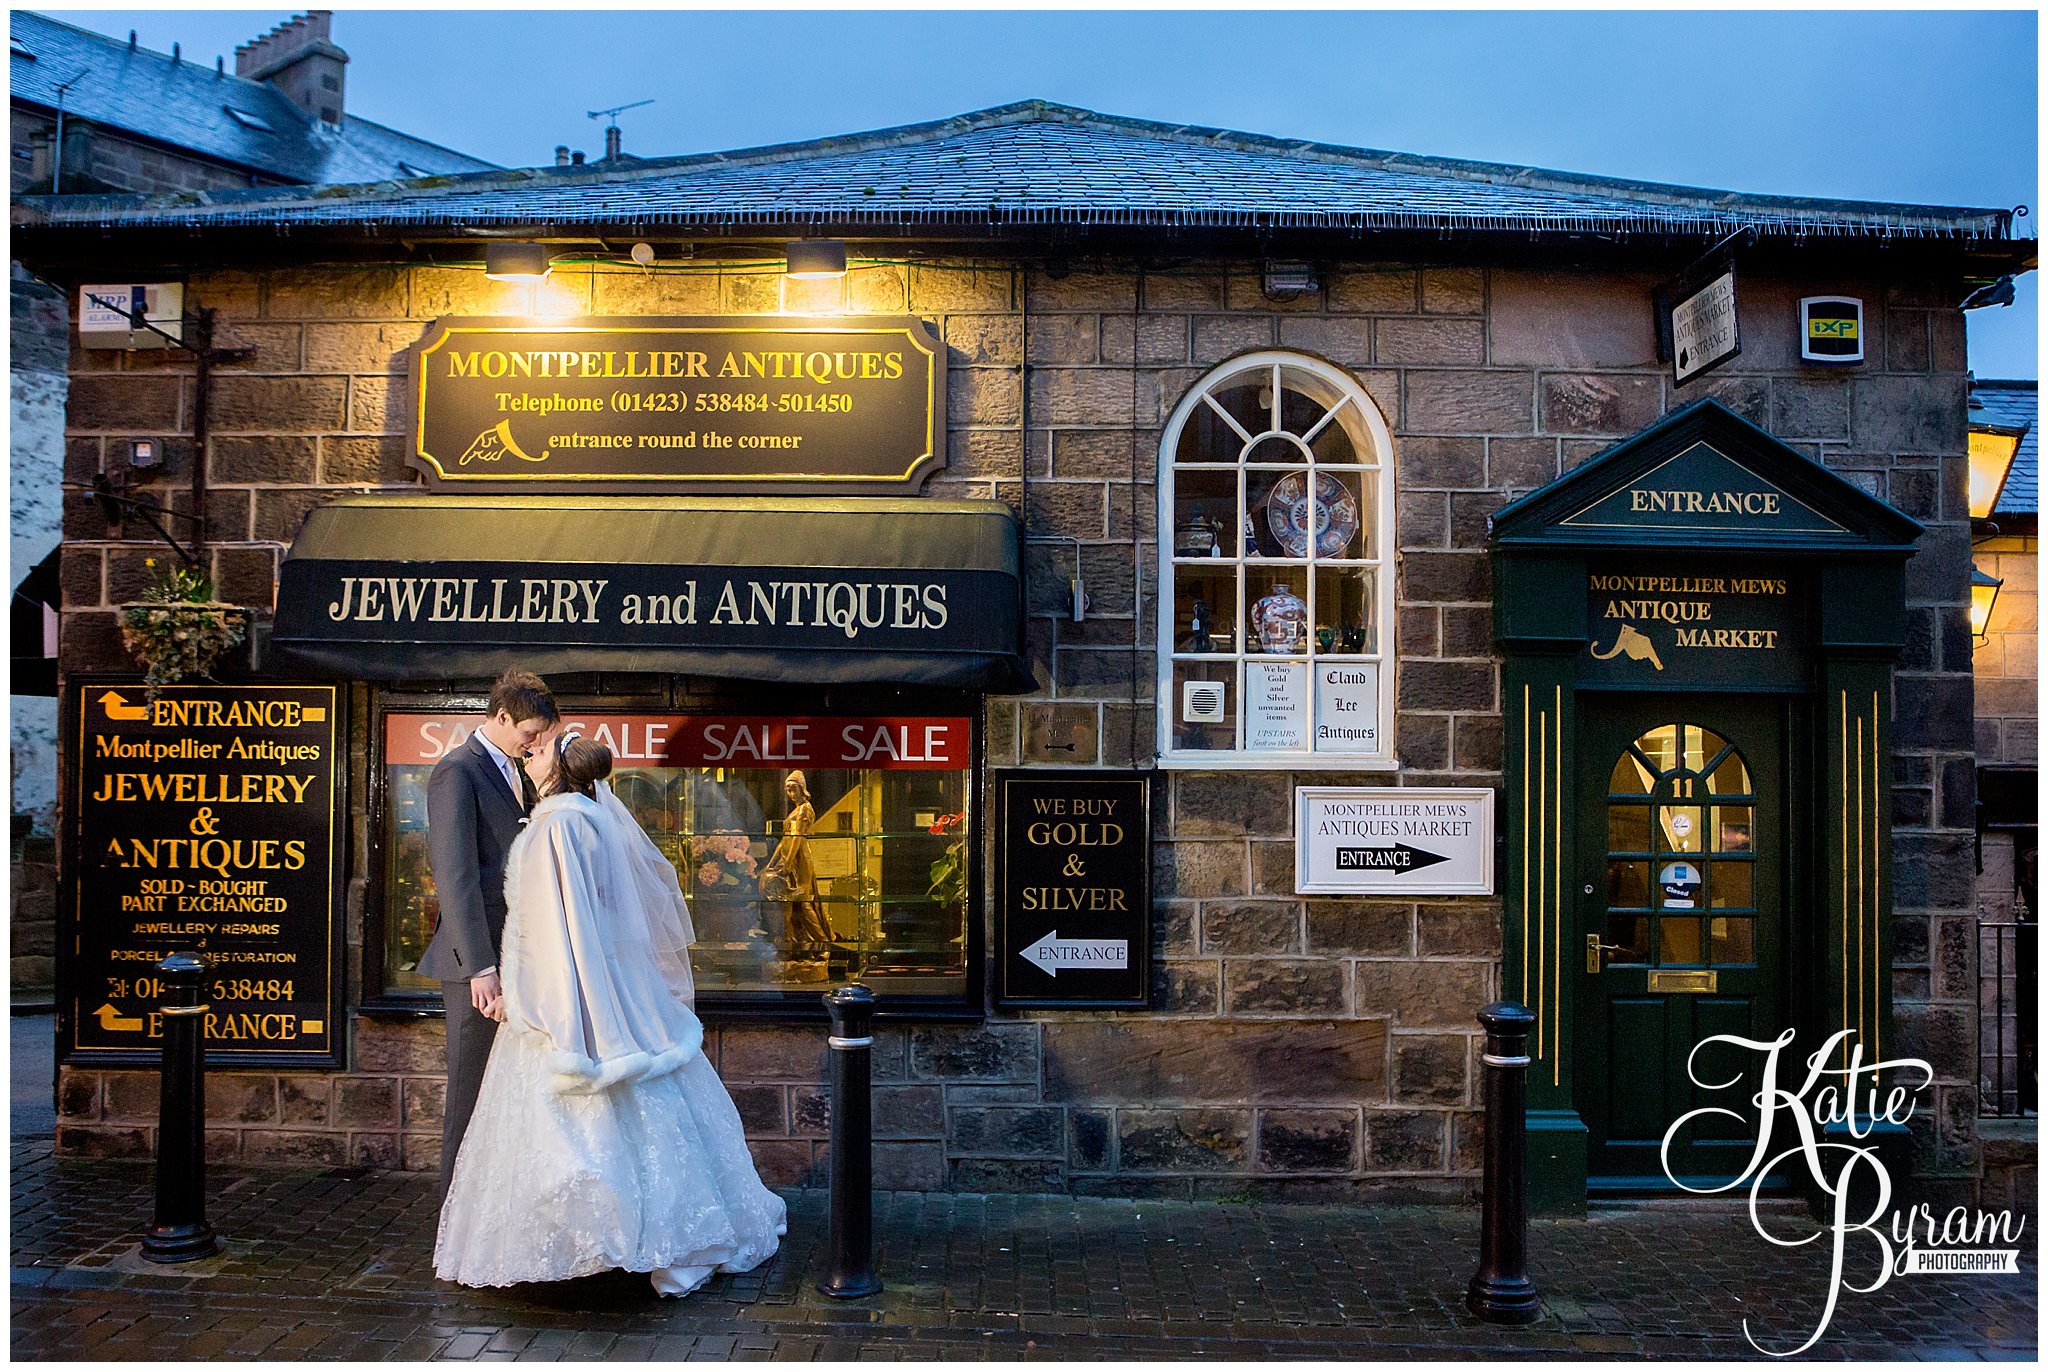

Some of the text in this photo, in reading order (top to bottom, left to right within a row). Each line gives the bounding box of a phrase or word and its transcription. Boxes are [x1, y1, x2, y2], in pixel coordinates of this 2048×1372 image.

[1704, 296, 1731, 326] MARKET
[1690, 327, 1729, 361] ENTRANCE
[446, 350, 904, 384] MONTPELLIER ANTIQUES
[495, 392, 604, 417] Telephone
[610, 391, 688, 415] (01423)
[548, 431, 803, 450] entrance round the corner
[1630, 489, 1781, 514] ENTRANCE
[1590, 575, 1787, 595] MONTPELLIER MEWS
[328, 577, 949, 639] JEWELLERY and ANTIQUES
[1604, 600, 1712, 624] ANTIQUE
[1675, 628, 1778, 649] MARKET
[1263, 665, 1292, 675] We buy
[1326, 671, 1366, 685] Claud
[1269, 684, 1284, 692] and
[152, 700, 302, 727] ENTRANCE
[1335, 698, 1358, 712] Lee
[703, 724, 810, 761] SALE
[841, 725, 949, 761] SALE
[1318, 725, 1375, 741] Antiques
[96, 735, 320, 765] Montpellier Antiques
[93, 774, 316, 803] JEWELLERY
[1672, 778, 1693, 798] 11
[1033, 798, 1118, 816] WE BUY
[1323, 804, 1467, 817] MONTPELLIER MEWS
[189, 806, 220, 835] &
[1318, 820, 1472, 839] ANTIQUES MARKET
[1027, 822, 1124, 846] GOLD
[100, 837, 306, 878] ANTIQUES
[1062, 853, 1087, 877] &
[1339, 851, 1411, 866] ENTRANCE
[140, 879, 184, 894] SOLD
[199, 880, 268, 895] BOUGHT
[1666, 886, 1690, 897] Closed
[121, 895, 288, 912] PART EXCHANGED
[1022, 887, 1129, 911] SILVER
[132, 923, 280, 935] JEWELLERY REPAIRS
[204, 952, 297, 963] RESTORATION
[1038, 946, 1126, 961] ENTRANCE
[212, 978, 295, 1000] 538484
[147, 1012, 297, 1040] ERANCE
